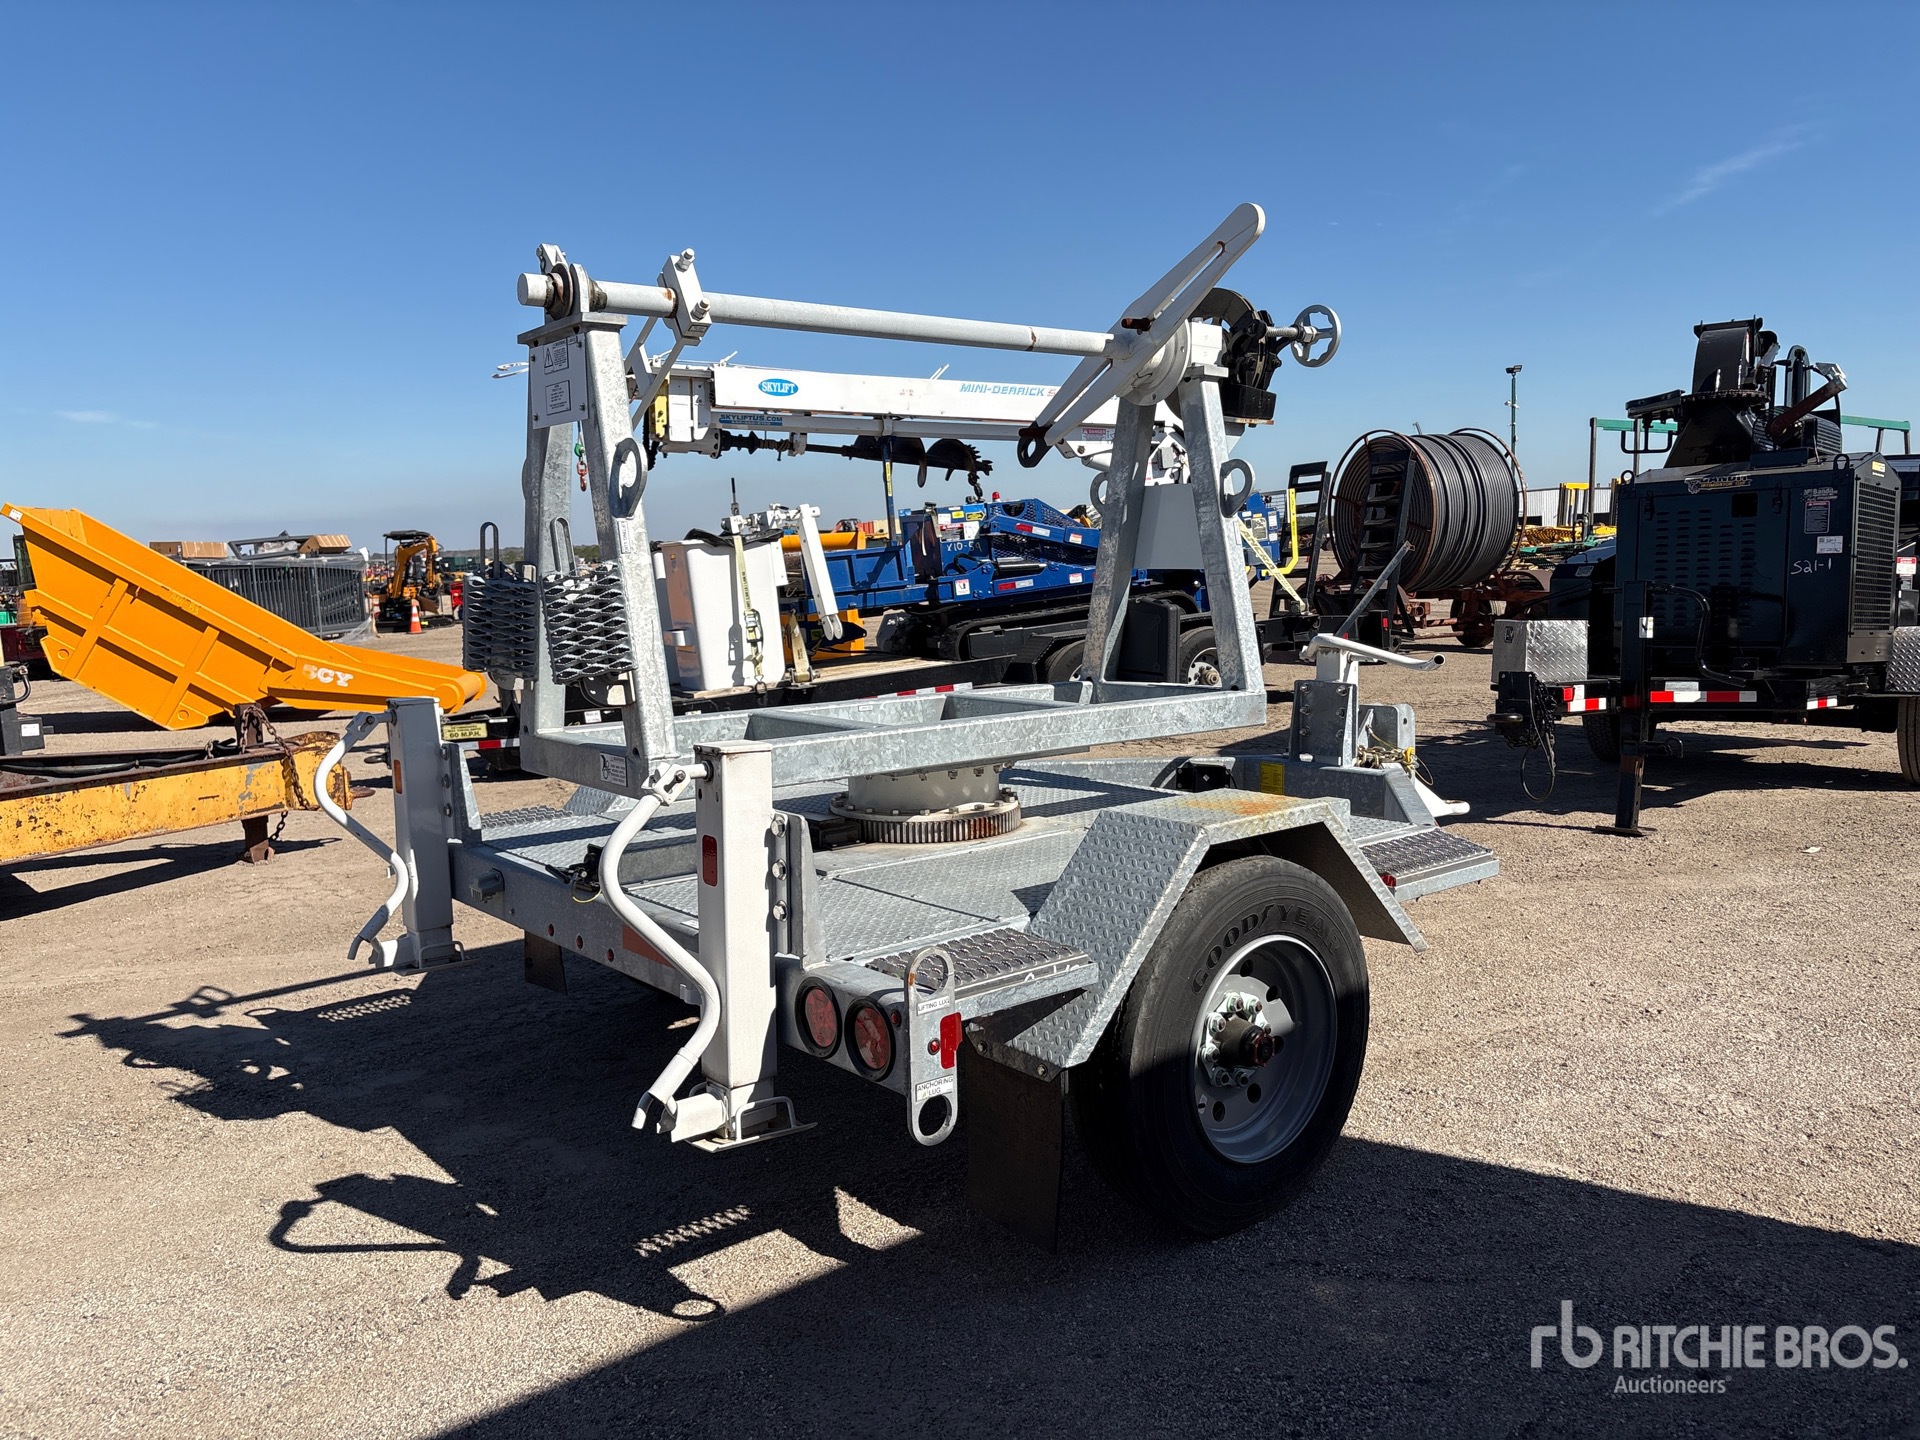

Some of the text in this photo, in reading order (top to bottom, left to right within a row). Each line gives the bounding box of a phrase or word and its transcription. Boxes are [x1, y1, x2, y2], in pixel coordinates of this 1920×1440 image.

[761, 381, 796, 394] SKYLIFT
[960, 383, 1045, 397] MINI-DERRICK
[720, 414, 783, 422] SKYLIFTUS.COM
[1790, 557, 1832, 575] S21-1
[1191, 903, 1342, 995] GOODYEAR
[918, 1000, 938, 1011] LIFTING
[917, 1076, 953, 1091] ANCHORING
[928, 1087, 941, 1095] LUG
